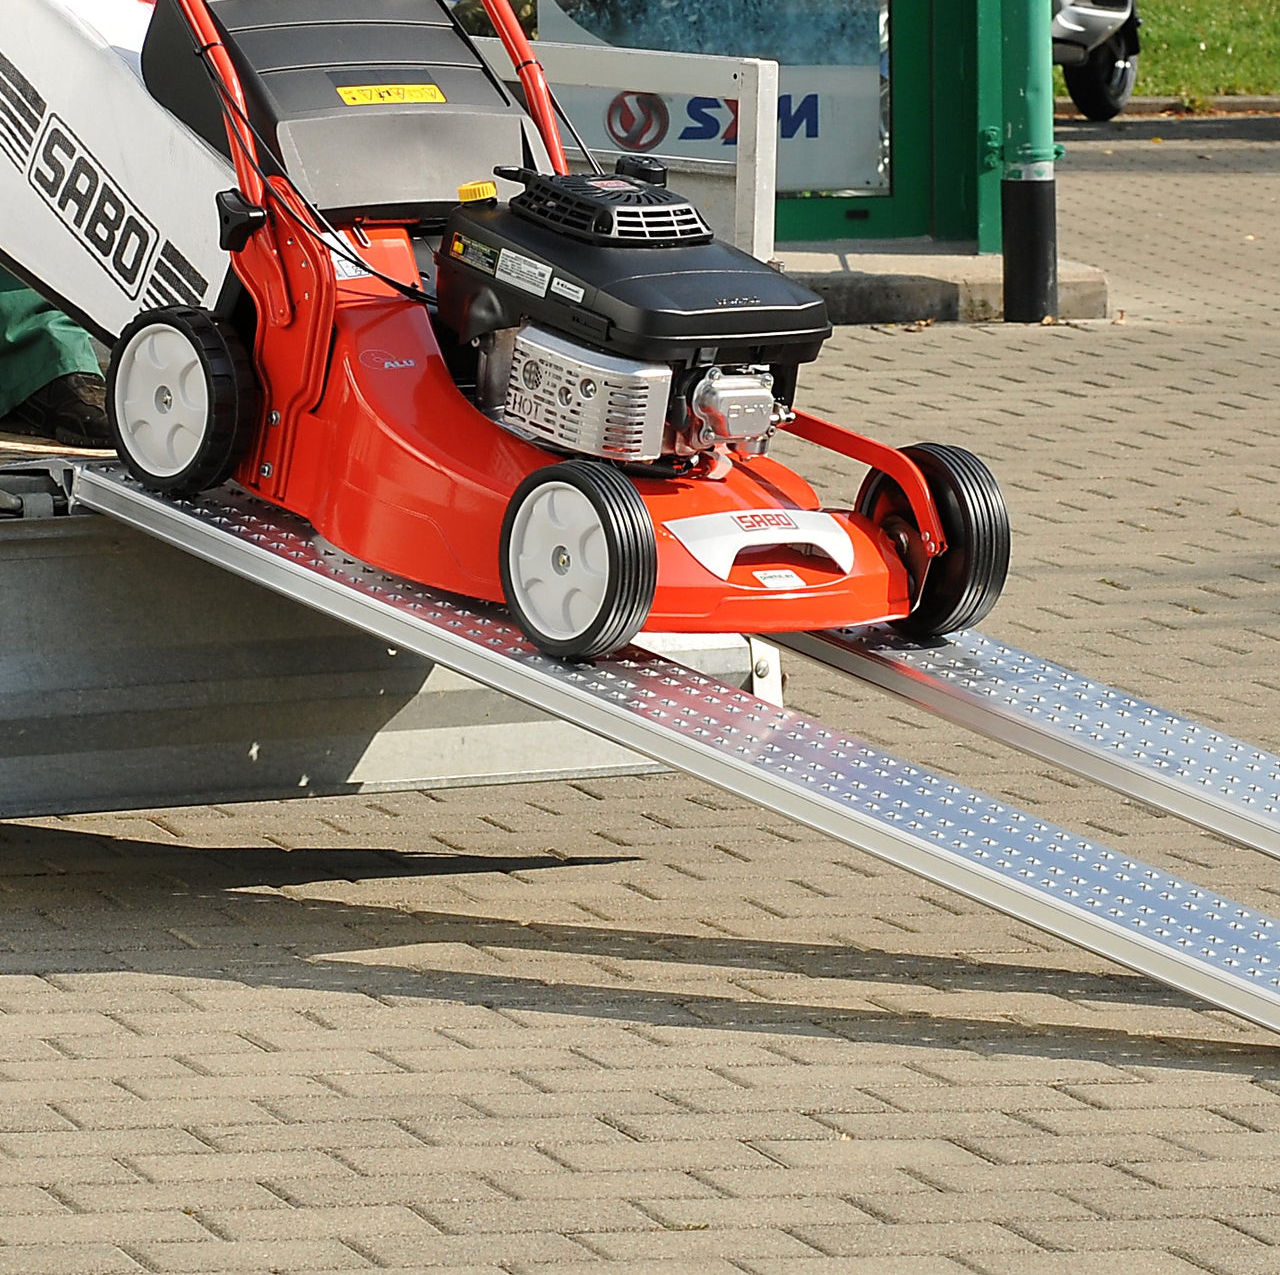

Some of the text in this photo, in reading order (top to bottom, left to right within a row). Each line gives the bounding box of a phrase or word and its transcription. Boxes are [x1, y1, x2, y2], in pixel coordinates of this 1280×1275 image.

[33, 128, 151, 291] SABO
[512, 392, 543, 419] HOT
[736, 513, 793, 529] SABO
